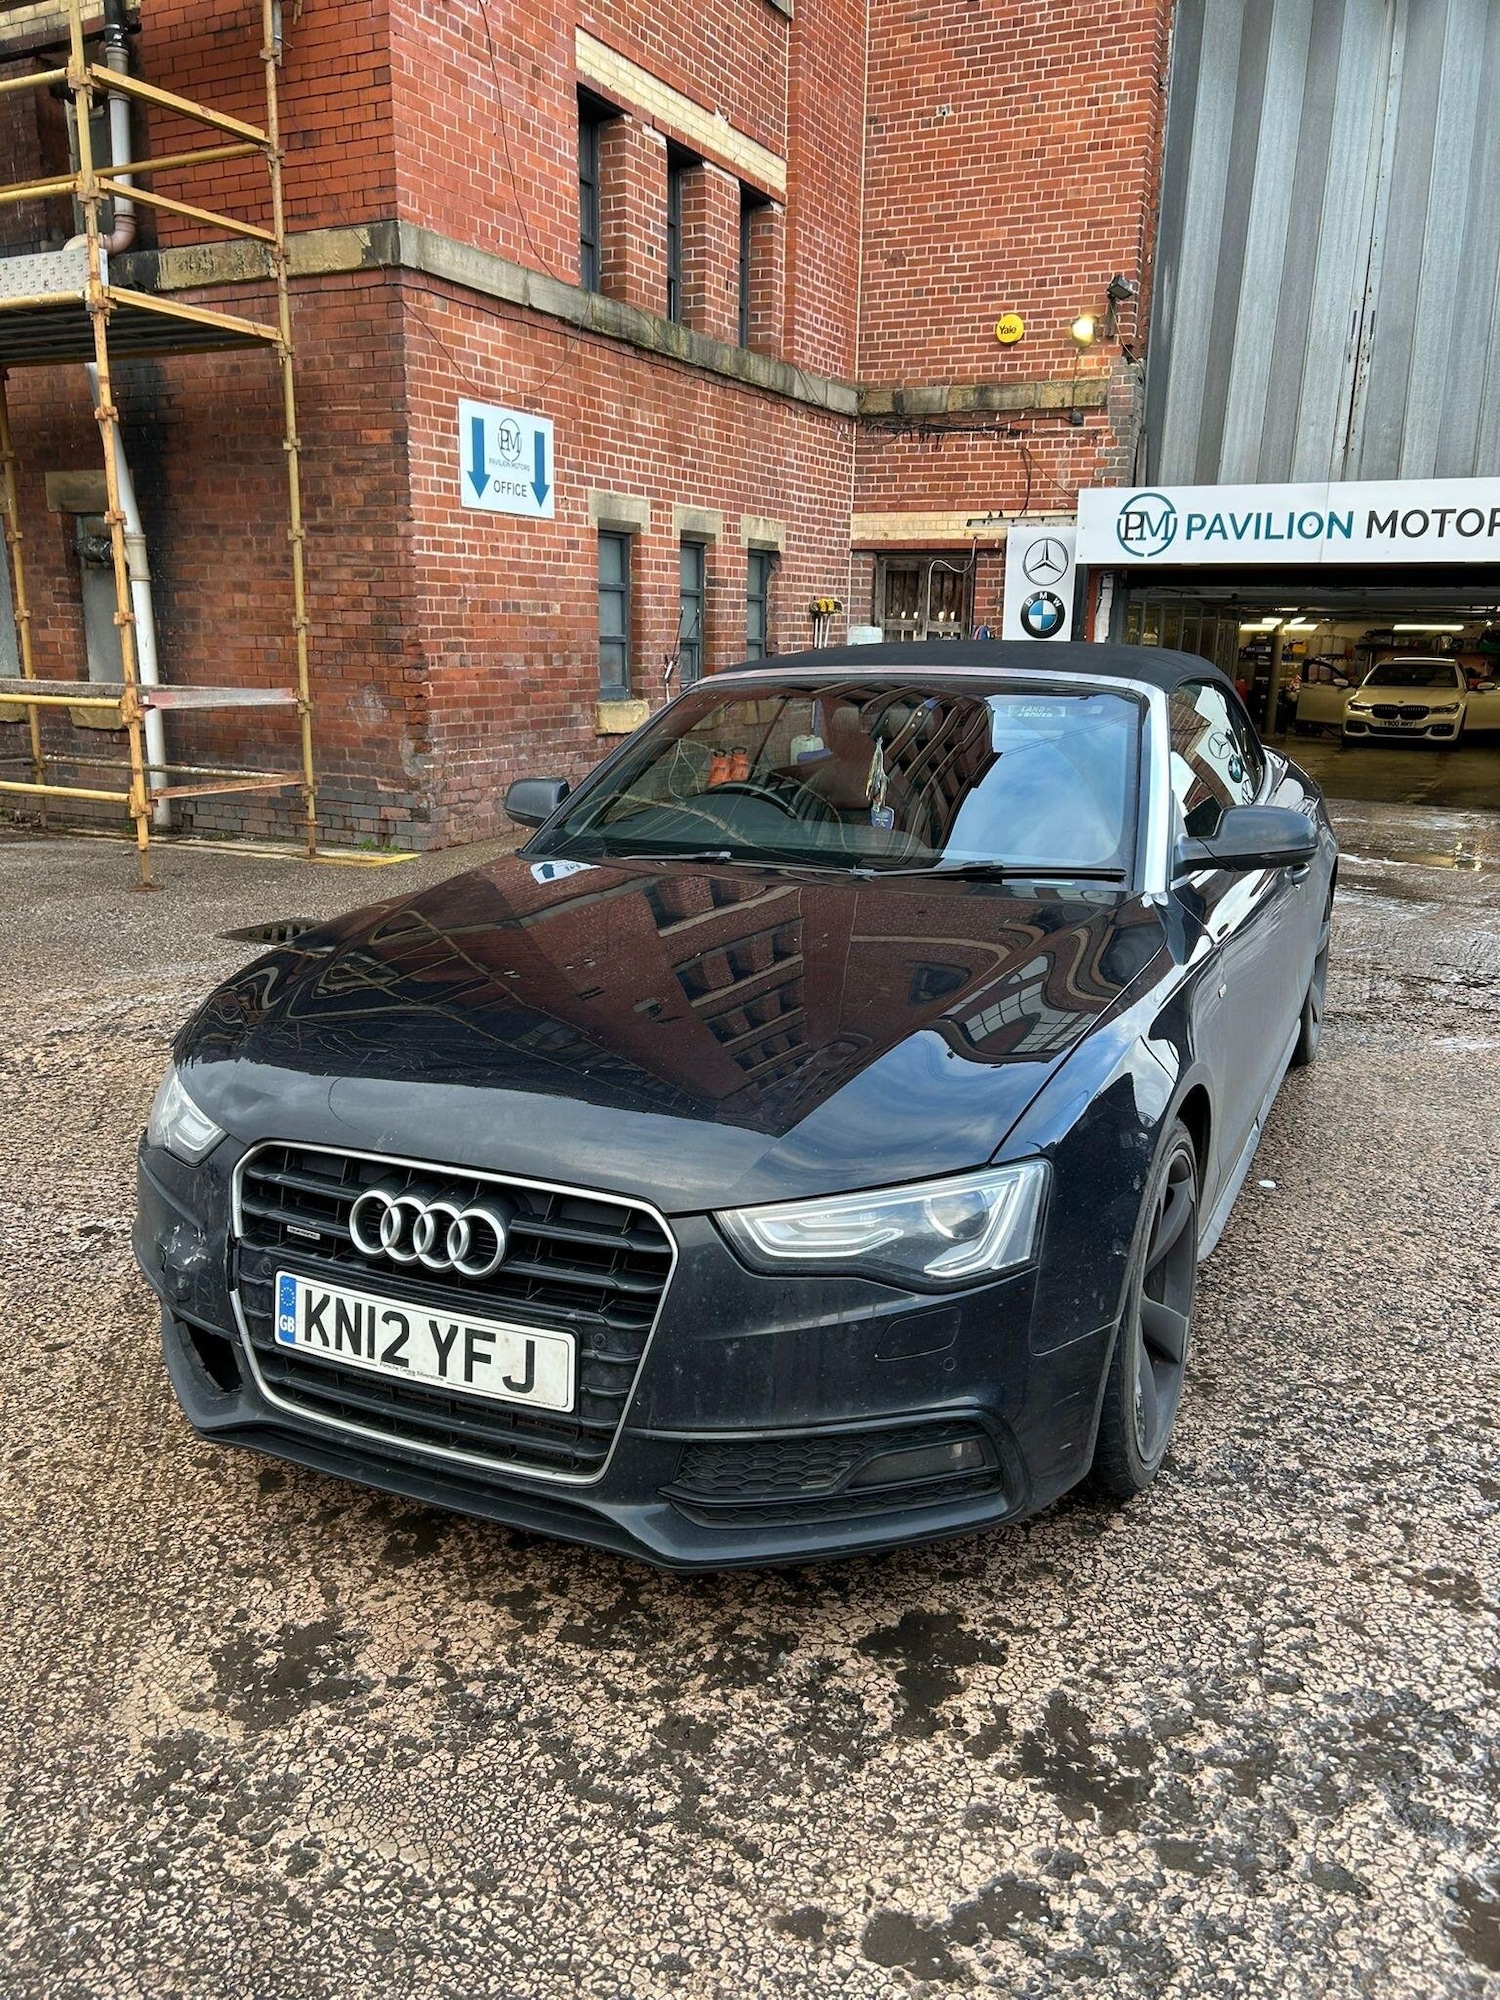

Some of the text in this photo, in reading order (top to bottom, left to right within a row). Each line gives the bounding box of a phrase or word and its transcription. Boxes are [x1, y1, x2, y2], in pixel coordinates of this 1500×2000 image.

[999, 325, 1017, 334] Yale
[493, 480, 528, 497] OFFICE
[1186, 510, 1354, 541] PAVILION
[1025, 591, 1062, 608] BMW
[279, 1316, 295, 1333] GB
[304, 1289, 535, 1394] KN12 YFJ
